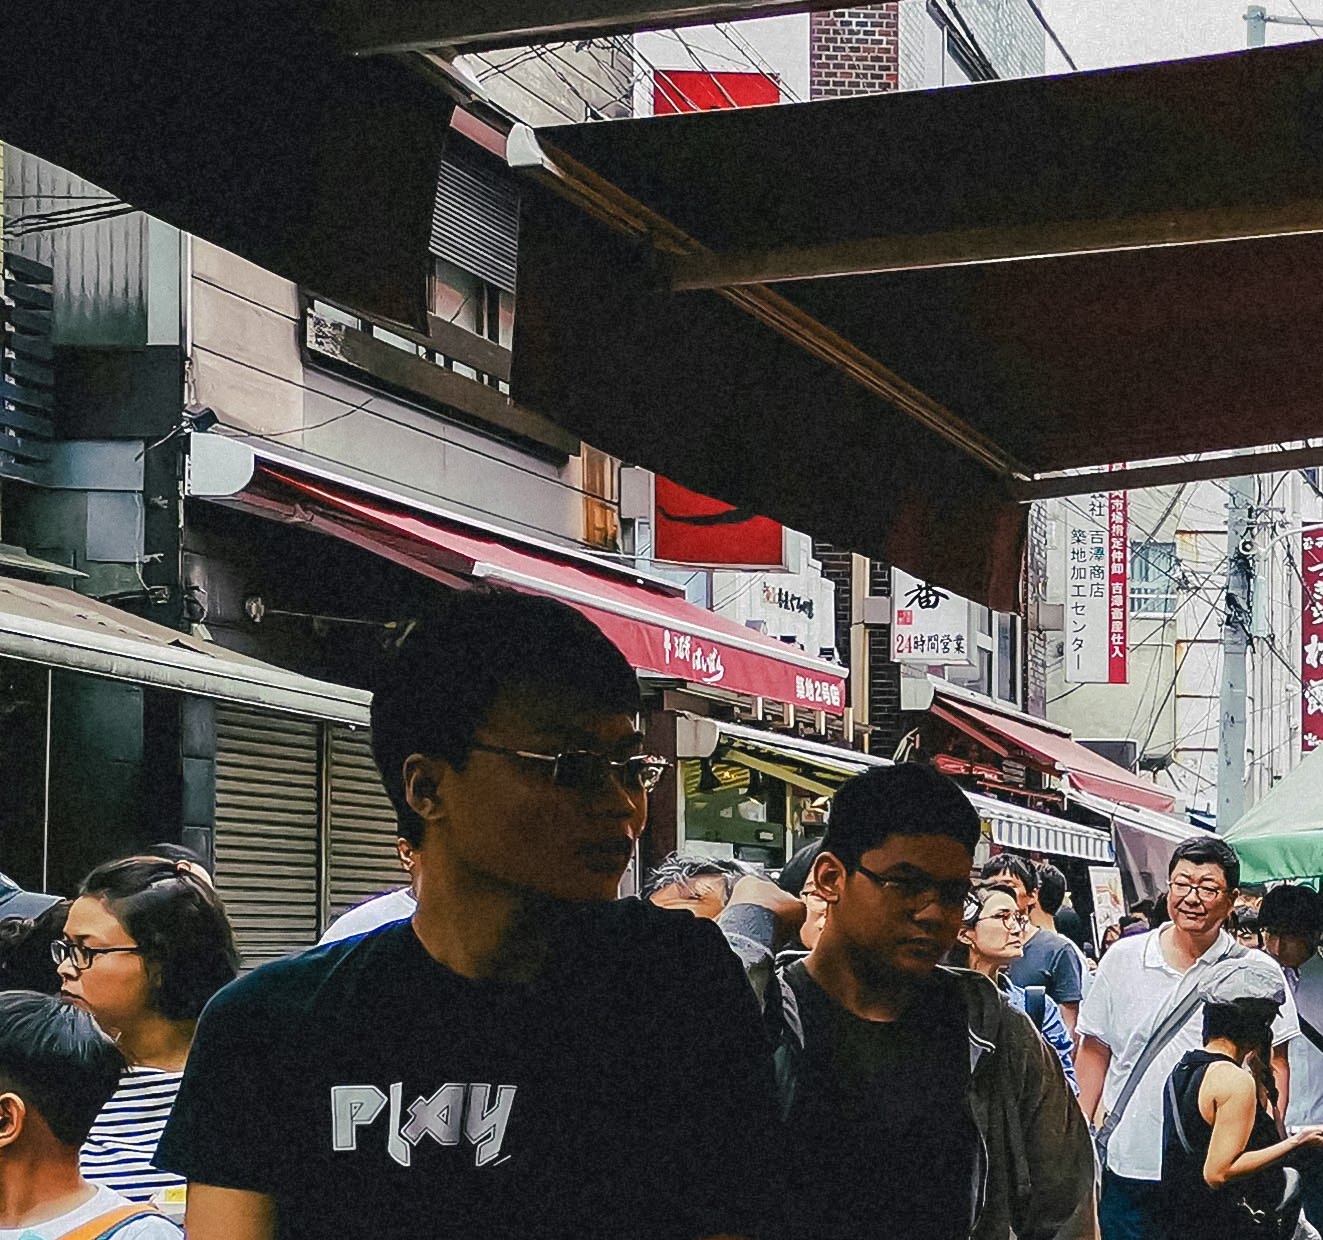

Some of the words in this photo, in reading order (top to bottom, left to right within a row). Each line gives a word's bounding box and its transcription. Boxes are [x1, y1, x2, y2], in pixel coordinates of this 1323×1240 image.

[1070, 528, 1087, 671] 築地加工センター
[896, 633, 965, 654] 24時間営業
[795, 674, 841, 707] 築地2号店
